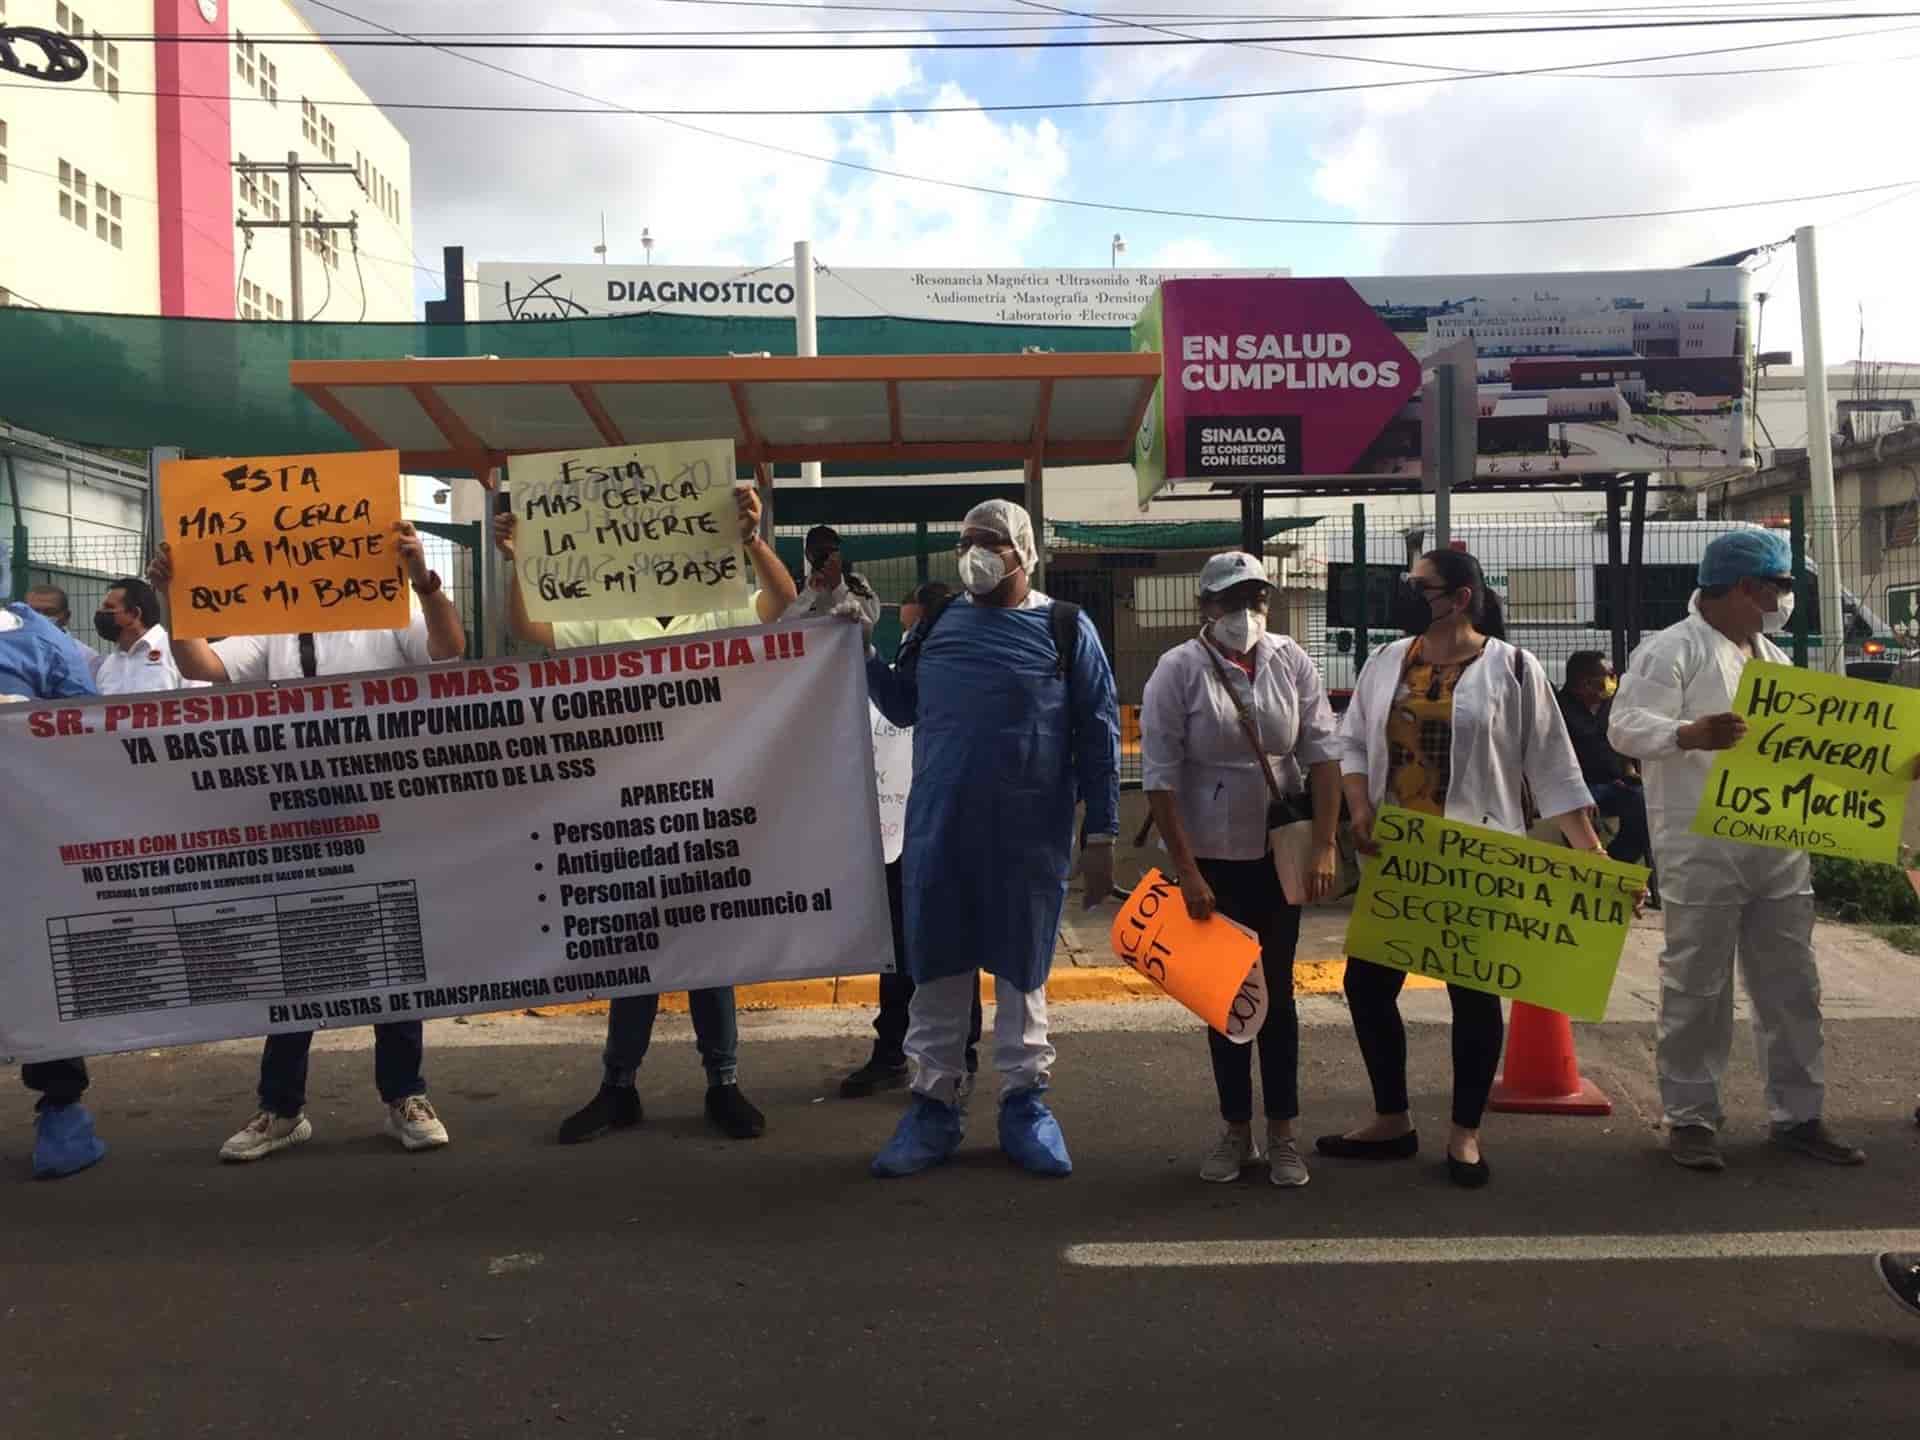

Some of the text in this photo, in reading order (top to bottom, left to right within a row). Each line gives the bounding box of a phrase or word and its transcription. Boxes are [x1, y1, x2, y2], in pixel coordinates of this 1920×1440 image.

[606, 280, 795, 304] DIAGNOSTICO
[915, 272, 984, 287] Resonancia
[986, 273, 1050, 289] Magnética
[1058, 272, 1130, 287] Ultrasonido
[1000, 309, 1072, 321] Laboratorio
[1181, 332, 1352, 361] EN SALUD
[1181, 360, 1400, 391] CUMPLIMOS
[1200, 427, 1286, 443] SINALOA
[1201, 443, 1287, 455] SE CONSTRUYE
[222, 464, 321, 493] ESTA
[1201, 454, 1287, 466] CON HECHOS
[179, 498, 370, 539] MAS CERCA
[526, 494, 582, 520] MAS
[602, 481, 704, 510] CERCA
[215, 533, 385, 569] LA MUERTE
[543, 528, 577, 556] LA
[595, 512, 720, 546] MUERTE
[190, 583, 249, 612] QUE
[262, 580, 299, 611] MI
[538, 572, 592, 601] QUE
[655, 555, 737, 586] BASE
[27, 631, 806, 738] SR. PRESIDENTE NO MAS INJUSTICIA !!!
[1747, 677, 1900, 731] HOSPITAL
[121, 675, 723, 765] YA BASTA DE TANTA IMPUNIDAD Y CORRUPCION
[191, 770, 217, 791] LA
[218, 763, 270, 789] BASE
[271, 761, 298, 783] YA
[300, 758, 326, 782] LA
[326, 748, 420, 779] TENEMOS
[422, 739, 503, 768] GANADA
[505, 734, 548, 759] CON
[1757, 722, 1895, 776] GENERAL
[269, 757, 597, 811] PERSONAL DE CONTRATO DE LA SSS
[620, 778, 714, 808] APARECEN
[1715, 768, 1772, 816] LOS
[57, 836, 136, 863] MIENTEN
[139, 831, 178, 855] CON
[180, 825, 242, 852] LISTAS
[244, 822, 268, 842] DE
[552, 804, 758, 846] Personas con base
[81, 837, 367, 885] NO EXISTEN CONTRATOS DESDE 1980
[556, 837, 741, 876] Antigüedad falsa
[1379, 813, 1646, 895] SR PRESIDENTE
[559, 866, 752, 907] Personal jubilado
[1379, 855, 1553, 908] AUDITORIA
[562, 887, 833, 938] Personal que renuncio al
[1370, 889, 1580, 946] SECRETARIA
[565, 930, 660, 961] contrato
[1441, 928, 1481, 956] DE
[1383, 938, 1522, 990] SALUD
[269, 965, 652, 1024] EN LAS LISTAS DE TRANSPARENCIA CUIDADANA
